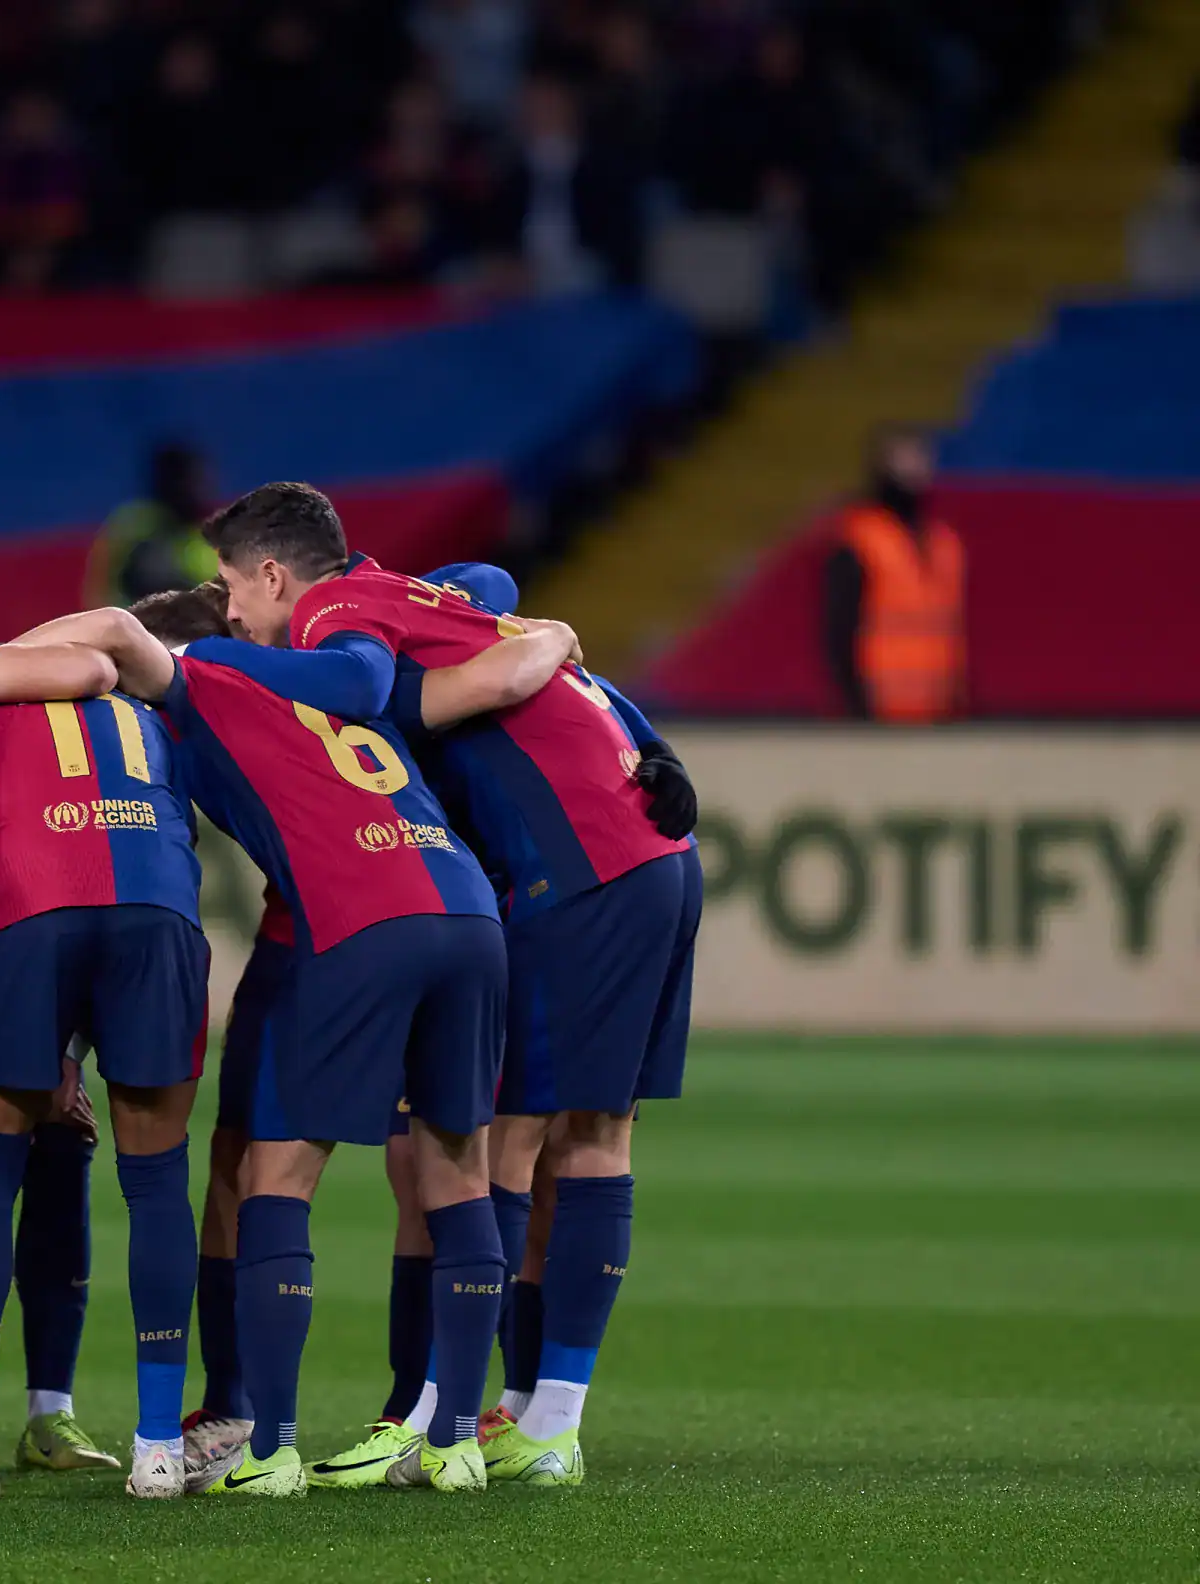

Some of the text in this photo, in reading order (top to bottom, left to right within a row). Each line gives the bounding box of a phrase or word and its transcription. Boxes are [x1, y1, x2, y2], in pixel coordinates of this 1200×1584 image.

[44, 694, 151, 779] 11
[292, 700, 410, 796] 6
[91, 800, 155, 815] UNHCR
[93, 811, 157, 826] ACNUR
[699, 808, 1187, 962] POTIFY
